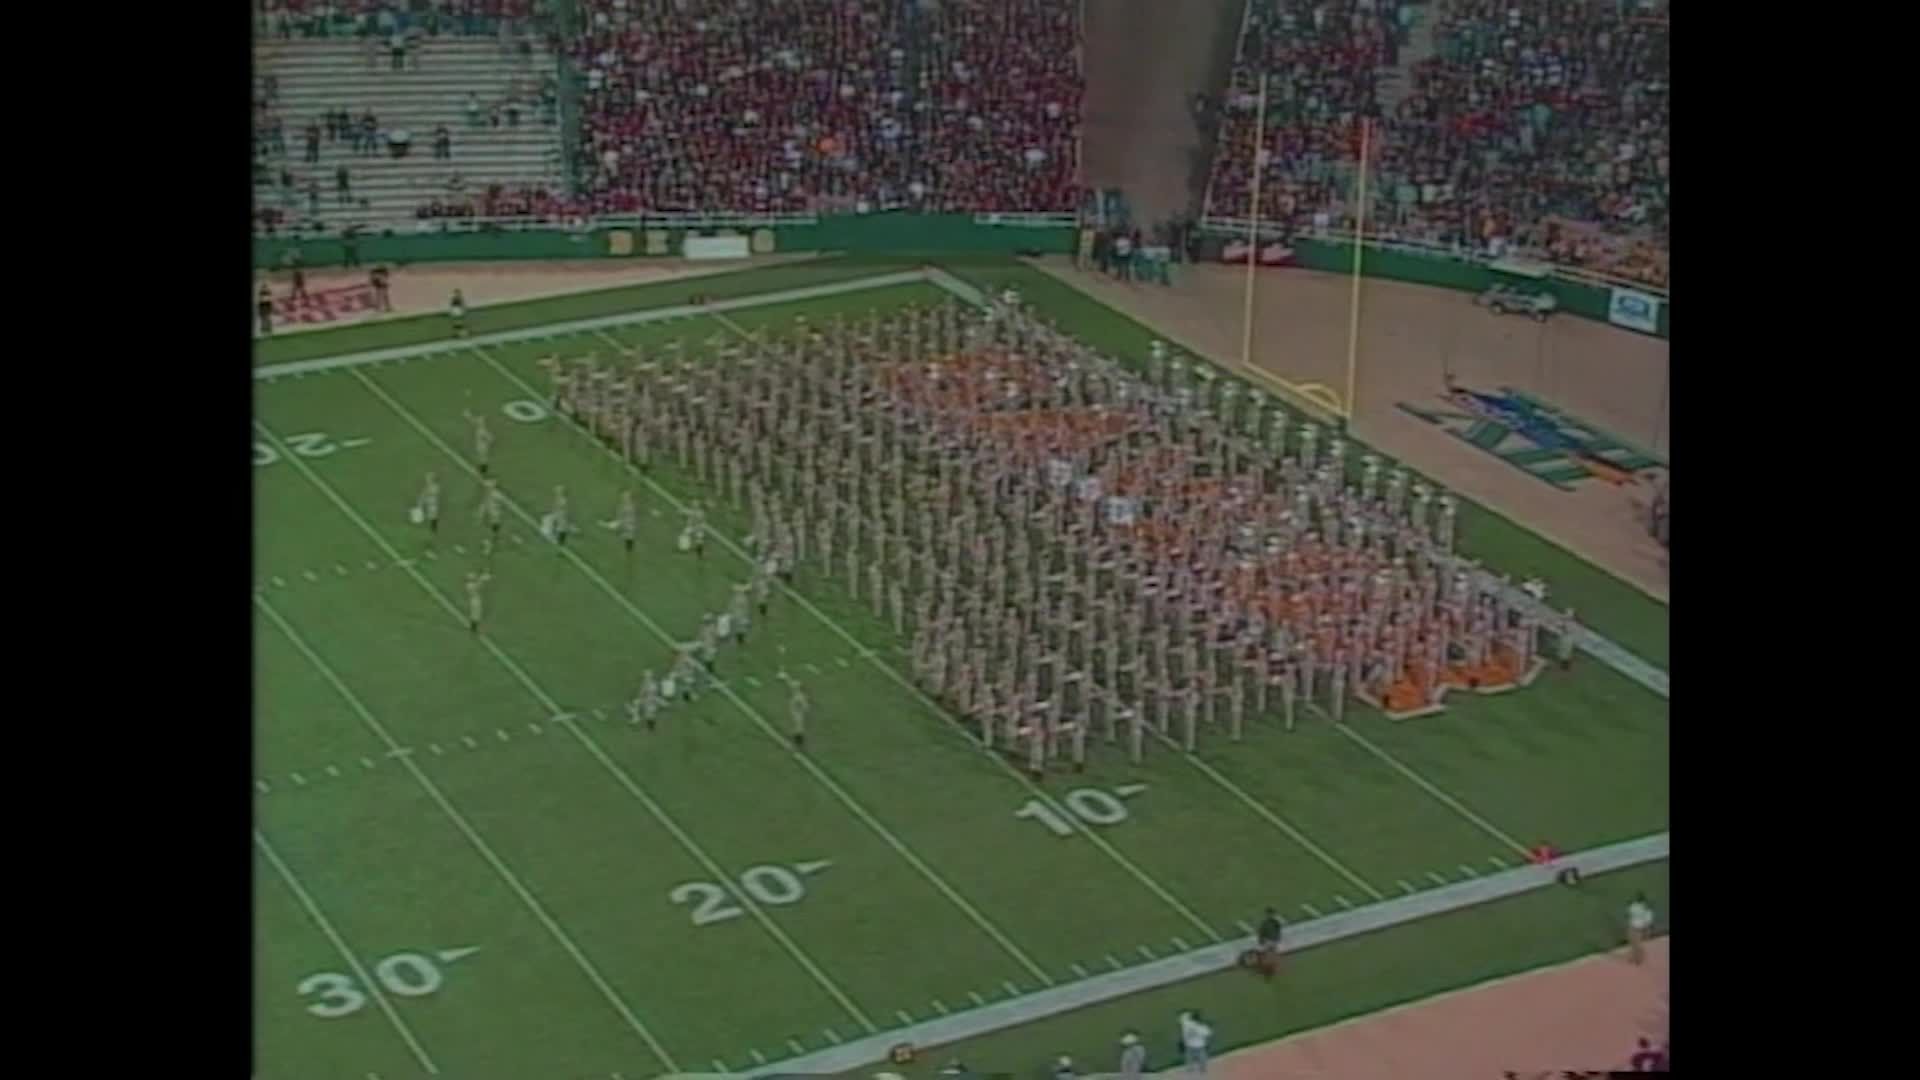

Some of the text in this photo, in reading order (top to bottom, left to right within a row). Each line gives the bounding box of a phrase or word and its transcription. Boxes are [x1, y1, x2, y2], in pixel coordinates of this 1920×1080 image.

[1014, 788, 1129, 835] 10
[671, 865, 805, 926] 20
[297, 953, 443, 1018] 30
